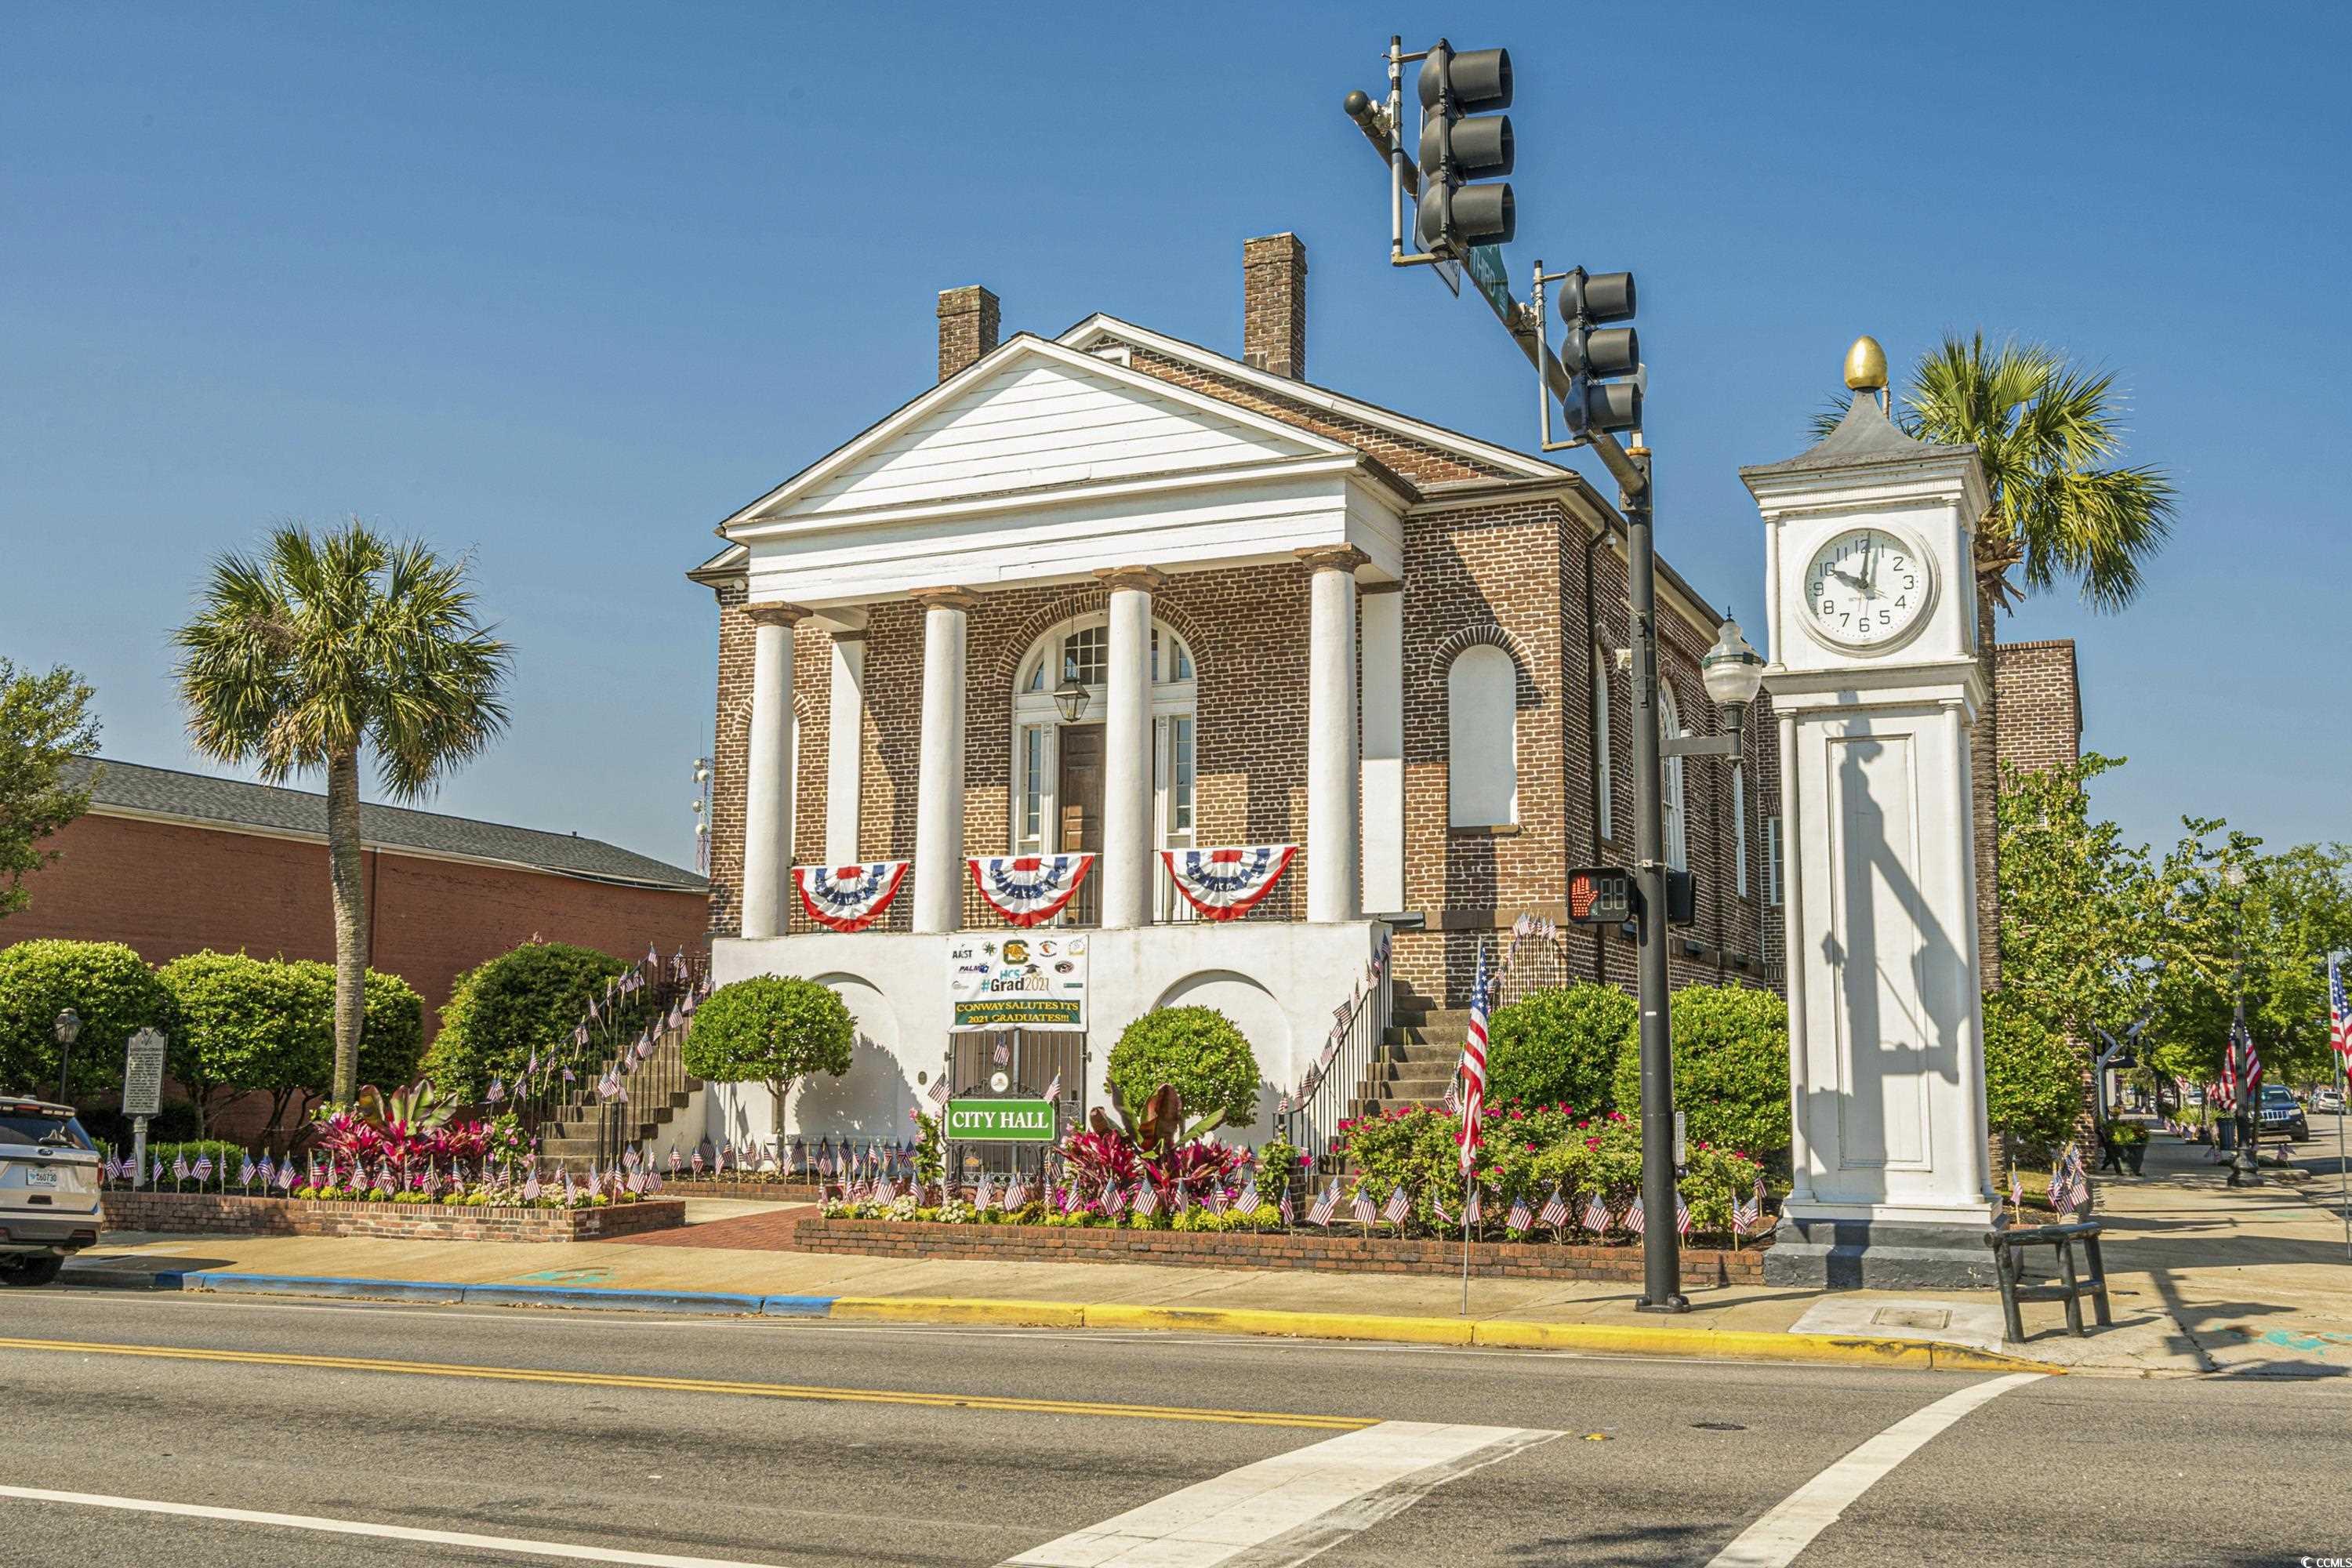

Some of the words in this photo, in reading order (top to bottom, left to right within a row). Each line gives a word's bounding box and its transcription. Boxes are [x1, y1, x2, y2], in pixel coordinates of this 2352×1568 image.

[1837, 546, 1848, 562] 11
[1820, 562, 1835, 577] 10
[1893, 557, 1904, 571] 2
[1813, 582, 1824, 597] 9
[1903, 575, 1915, 590] 3
[1824, 600, 1834, 615] 8
[1894, 595, 1907, 609] 4
[1839, 612, 1850, 627] 7
[1879, 610, 1890, 625] 5
[1859, 618, 1870, 633] 6
[1000, 969, 1020, 980] HCS
[956, 1002, 1004, 1012] CONWAY
[1006, 1001, 1058, 1011] SALUTES
[1060, 1001, 1079, 1011] ITS
[967, 1015, 989, 1024] 2021
[991, 1013, 1069, 1023] GRADUATES!!!
[952, 1111, 996, 1128] CITY
[1000, 1112, 1049, 1129] HALL
